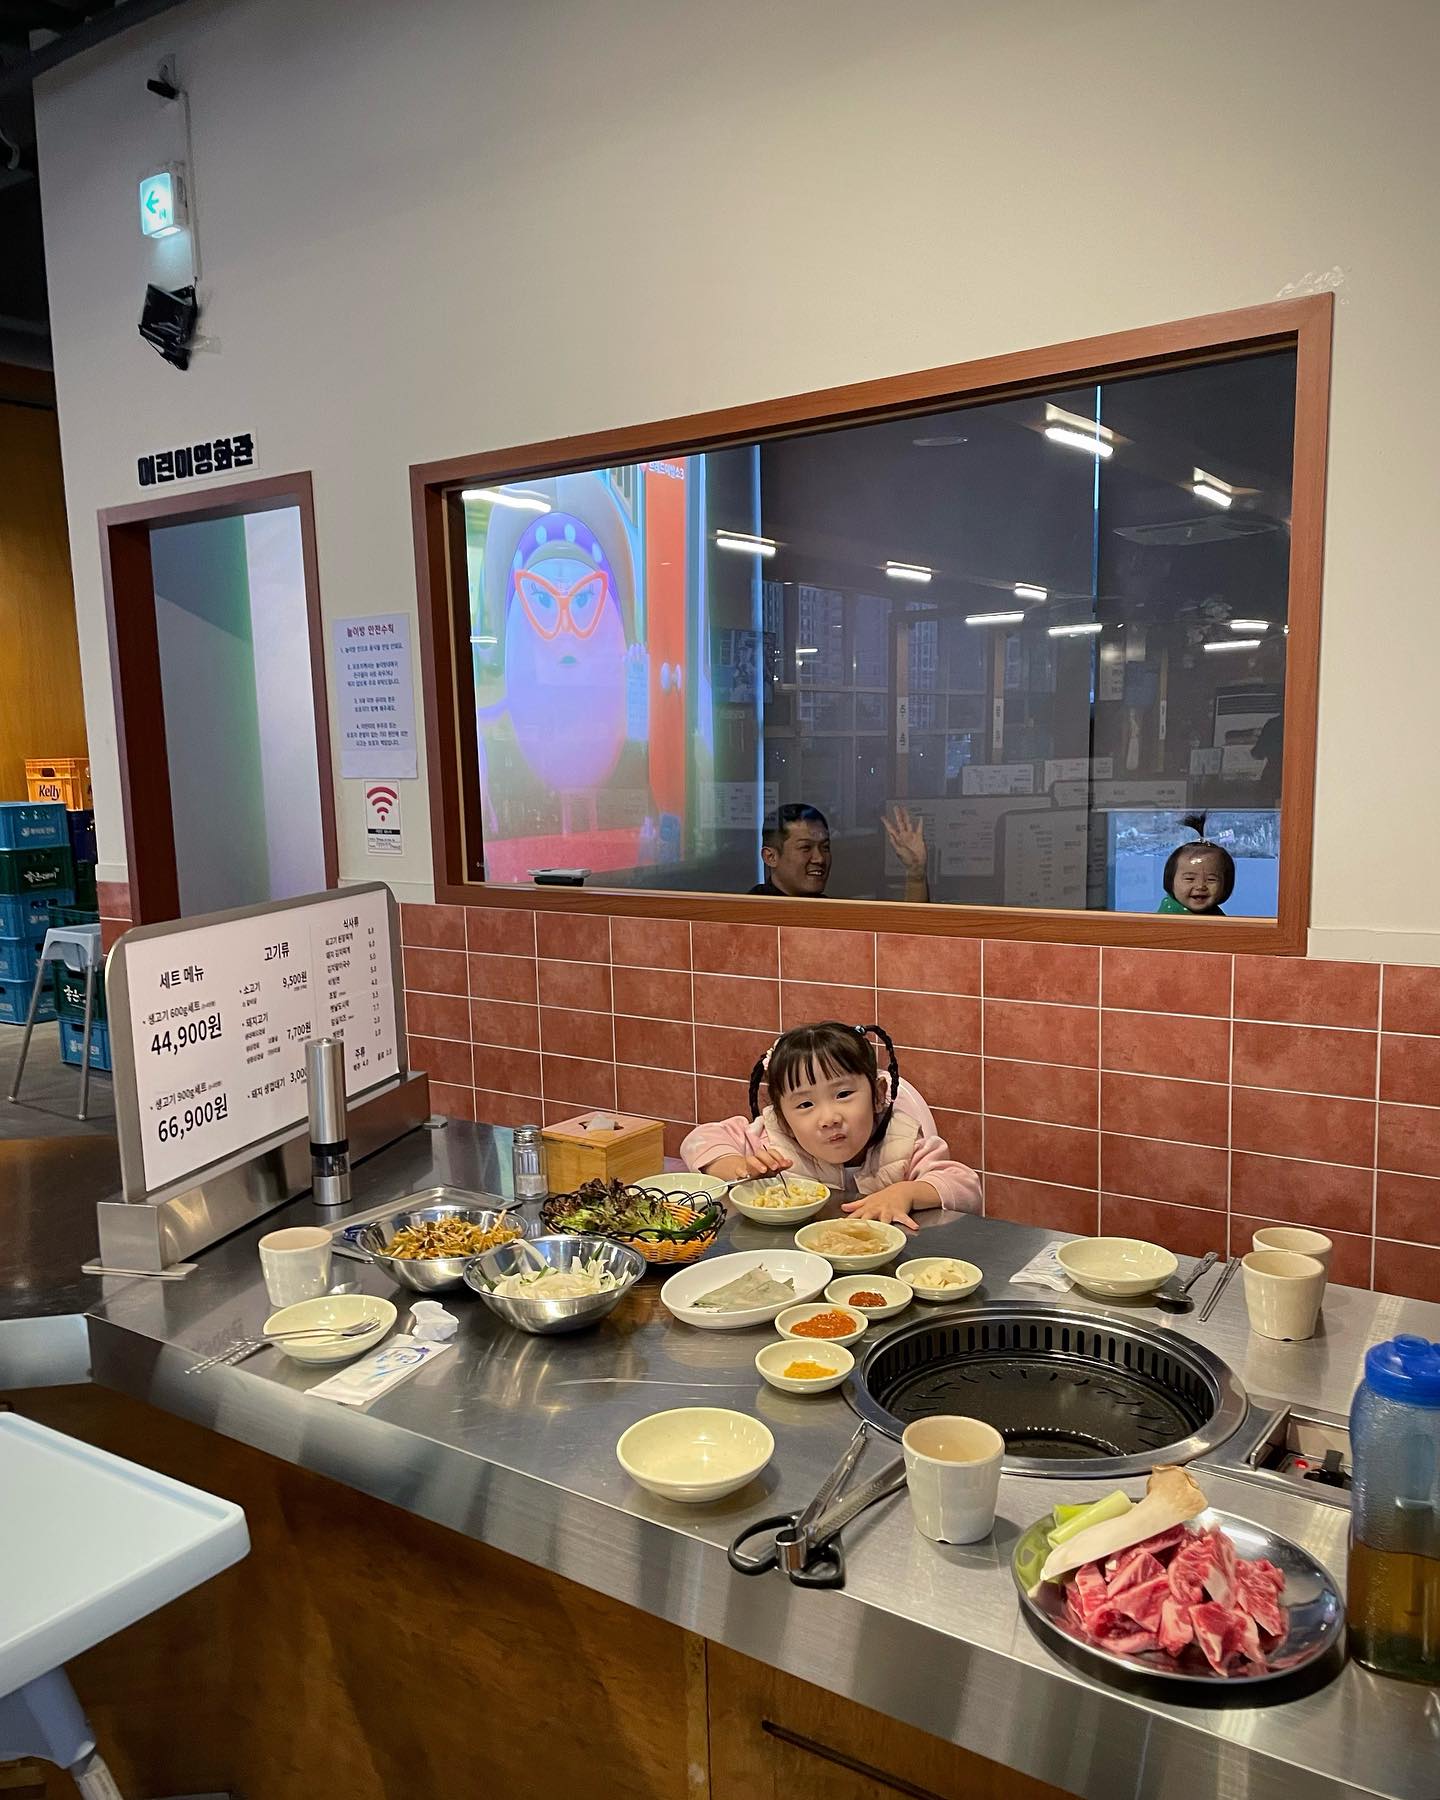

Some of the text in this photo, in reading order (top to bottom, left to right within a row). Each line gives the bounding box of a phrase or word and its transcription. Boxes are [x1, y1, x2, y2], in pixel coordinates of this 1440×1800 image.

[137, 433, 254, 486] 어린이영화관
[346, 624, 394, 638] 놀이방 안전수칙
[39, 784, 61, 801] Kelly
[264, 941, 290, 961] 고기류
[159, 964, 205, 990] 세트 메뉴
[243, 980, 261, 995] 소고기
[282, 970, 308, 989] 9,500원
[148, 1009, 170, 1026] 생고기
[245, 1011, 269, 1028] 돼지고기
[151, 1012, 222, 1056] 44,900원
[287, 1020, 312, 1041] 7,700원
[156, 1093, 176, 1111] 생고기
[158, 1092, 229, 1143] 66,900원
